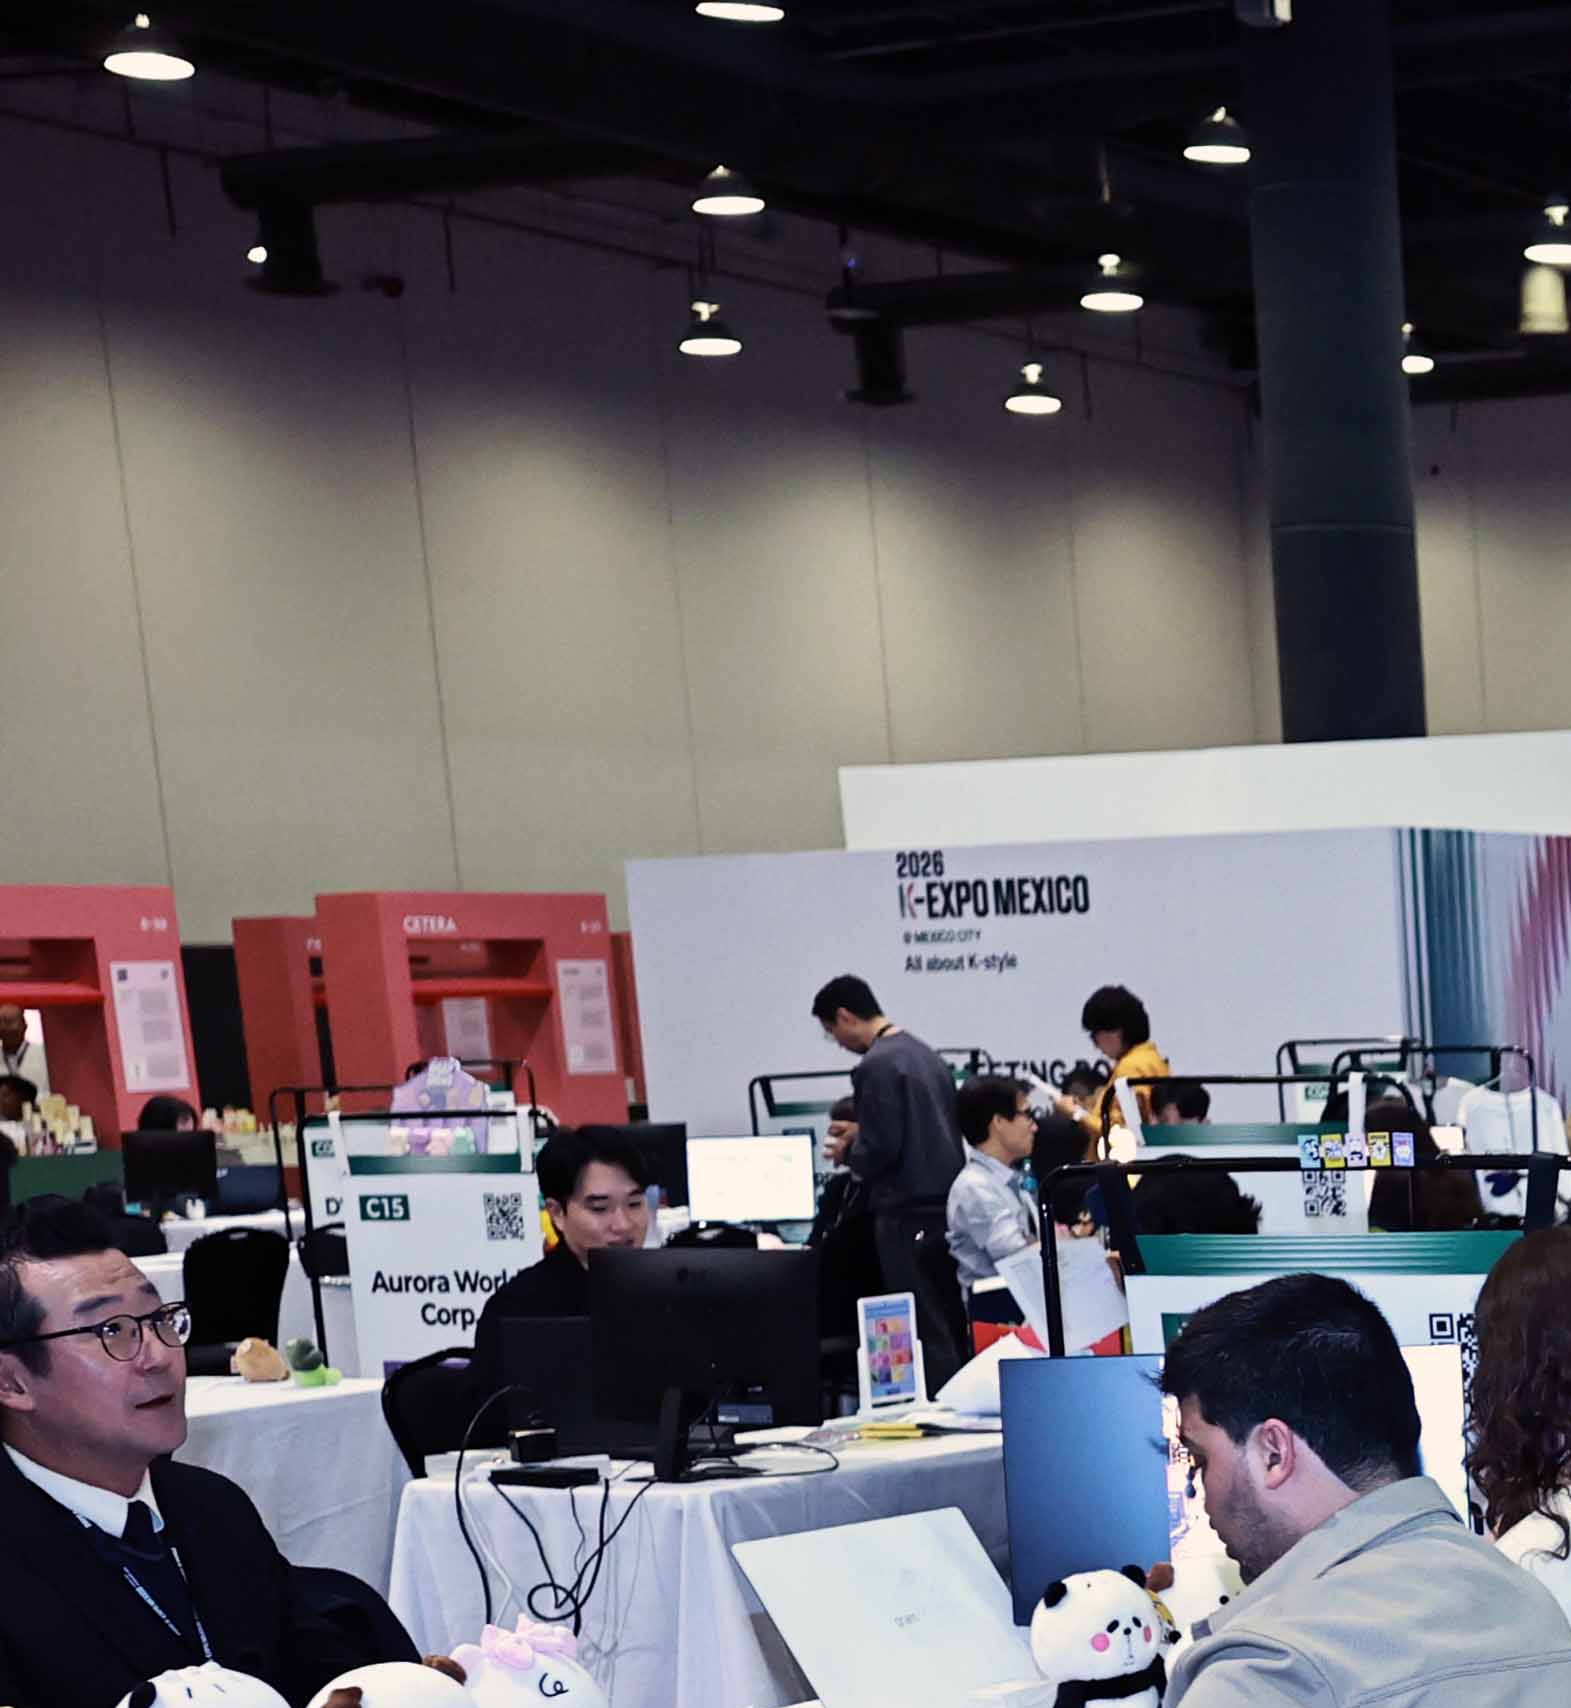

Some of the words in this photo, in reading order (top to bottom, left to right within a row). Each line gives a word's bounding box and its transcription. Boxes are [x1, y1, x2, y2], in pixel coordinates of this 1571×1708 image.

[896, 850, 944, 878] 2026
[899, 879, 989, 919] K-EXPO
[993, 875, 1090, 915] MEXICO
[366, 1198, 404, 1219] C15
[372, 1271, 449, 1293] Aurora
[454, 1269, 521, 1293] Worl
